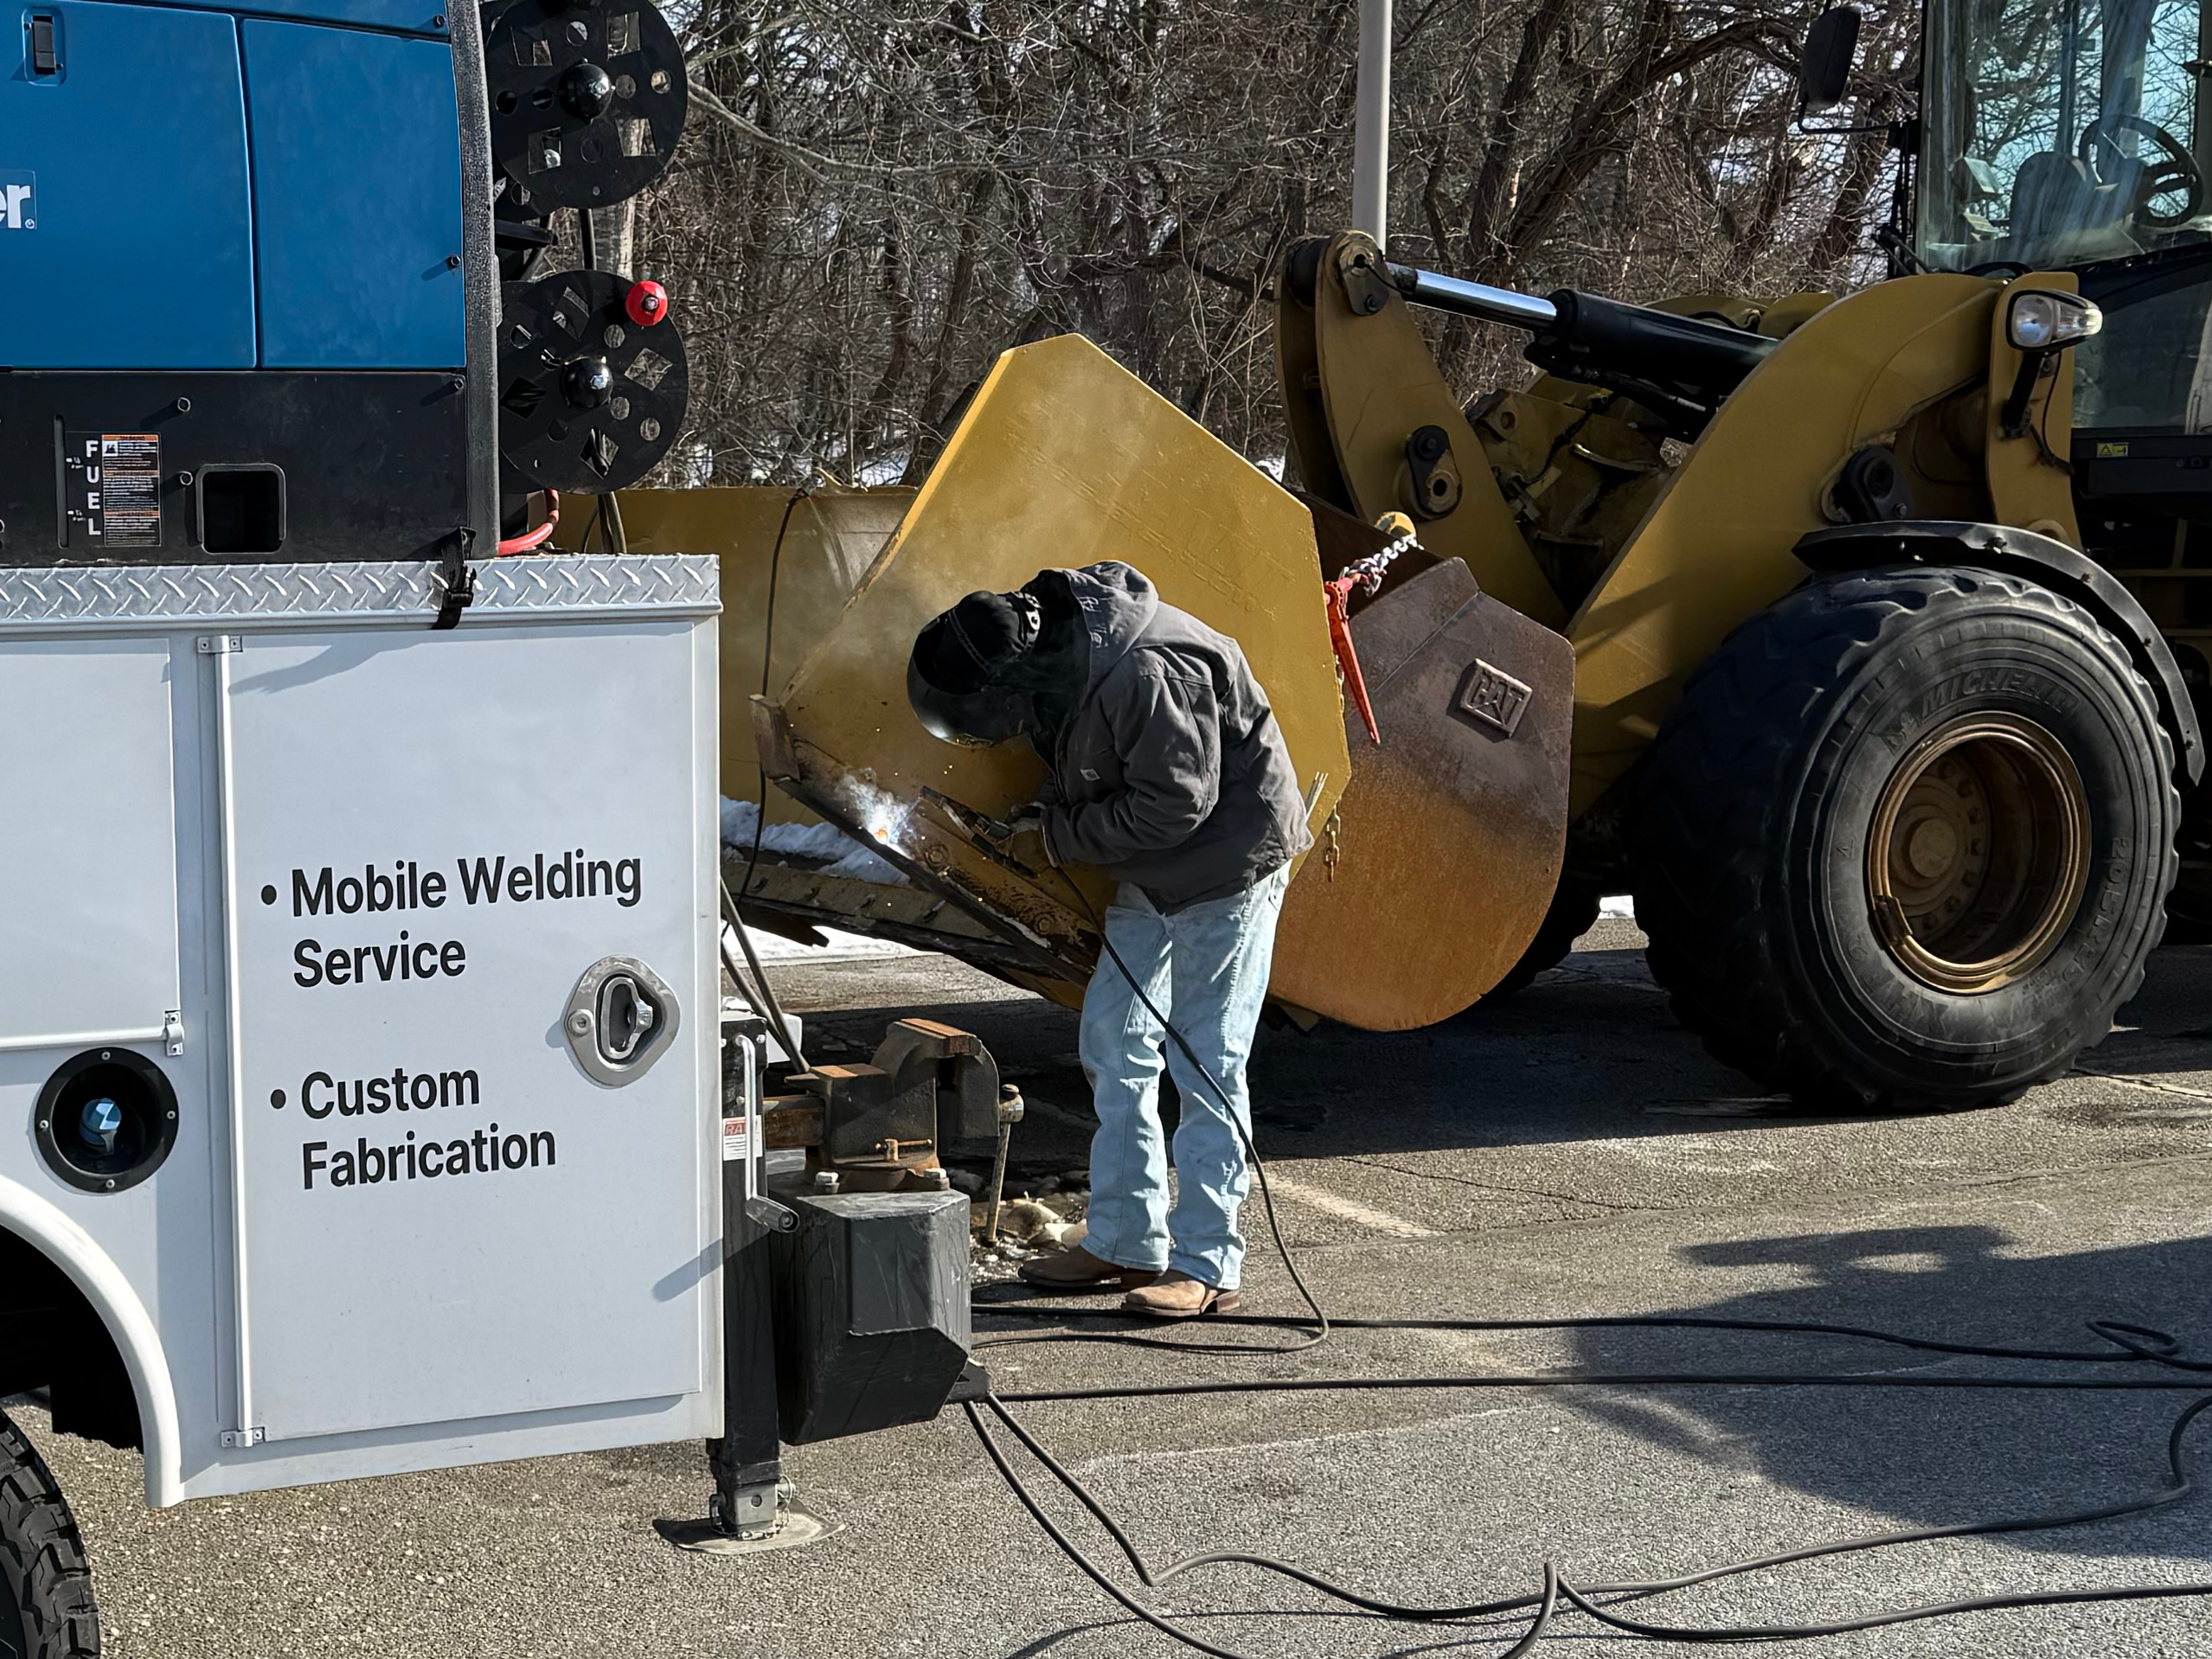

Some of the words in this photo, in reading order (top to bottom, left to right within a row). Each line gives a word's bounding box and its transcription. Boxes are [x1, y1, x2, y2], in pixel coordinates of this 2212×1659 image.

[85, 439, 101, 535] FUEL
[1469, 669, 1526, 726] CAT
[1921, 668, 2076, 716] MICHELIN
[292, 860, 446, 917] Mobile
[458, 849, 642, 907] Welding
[293, 930, 466, 987] Service
[301, 1068, 479, 1118] Custom
[303, 1122, 556, 1189] Fabrication
